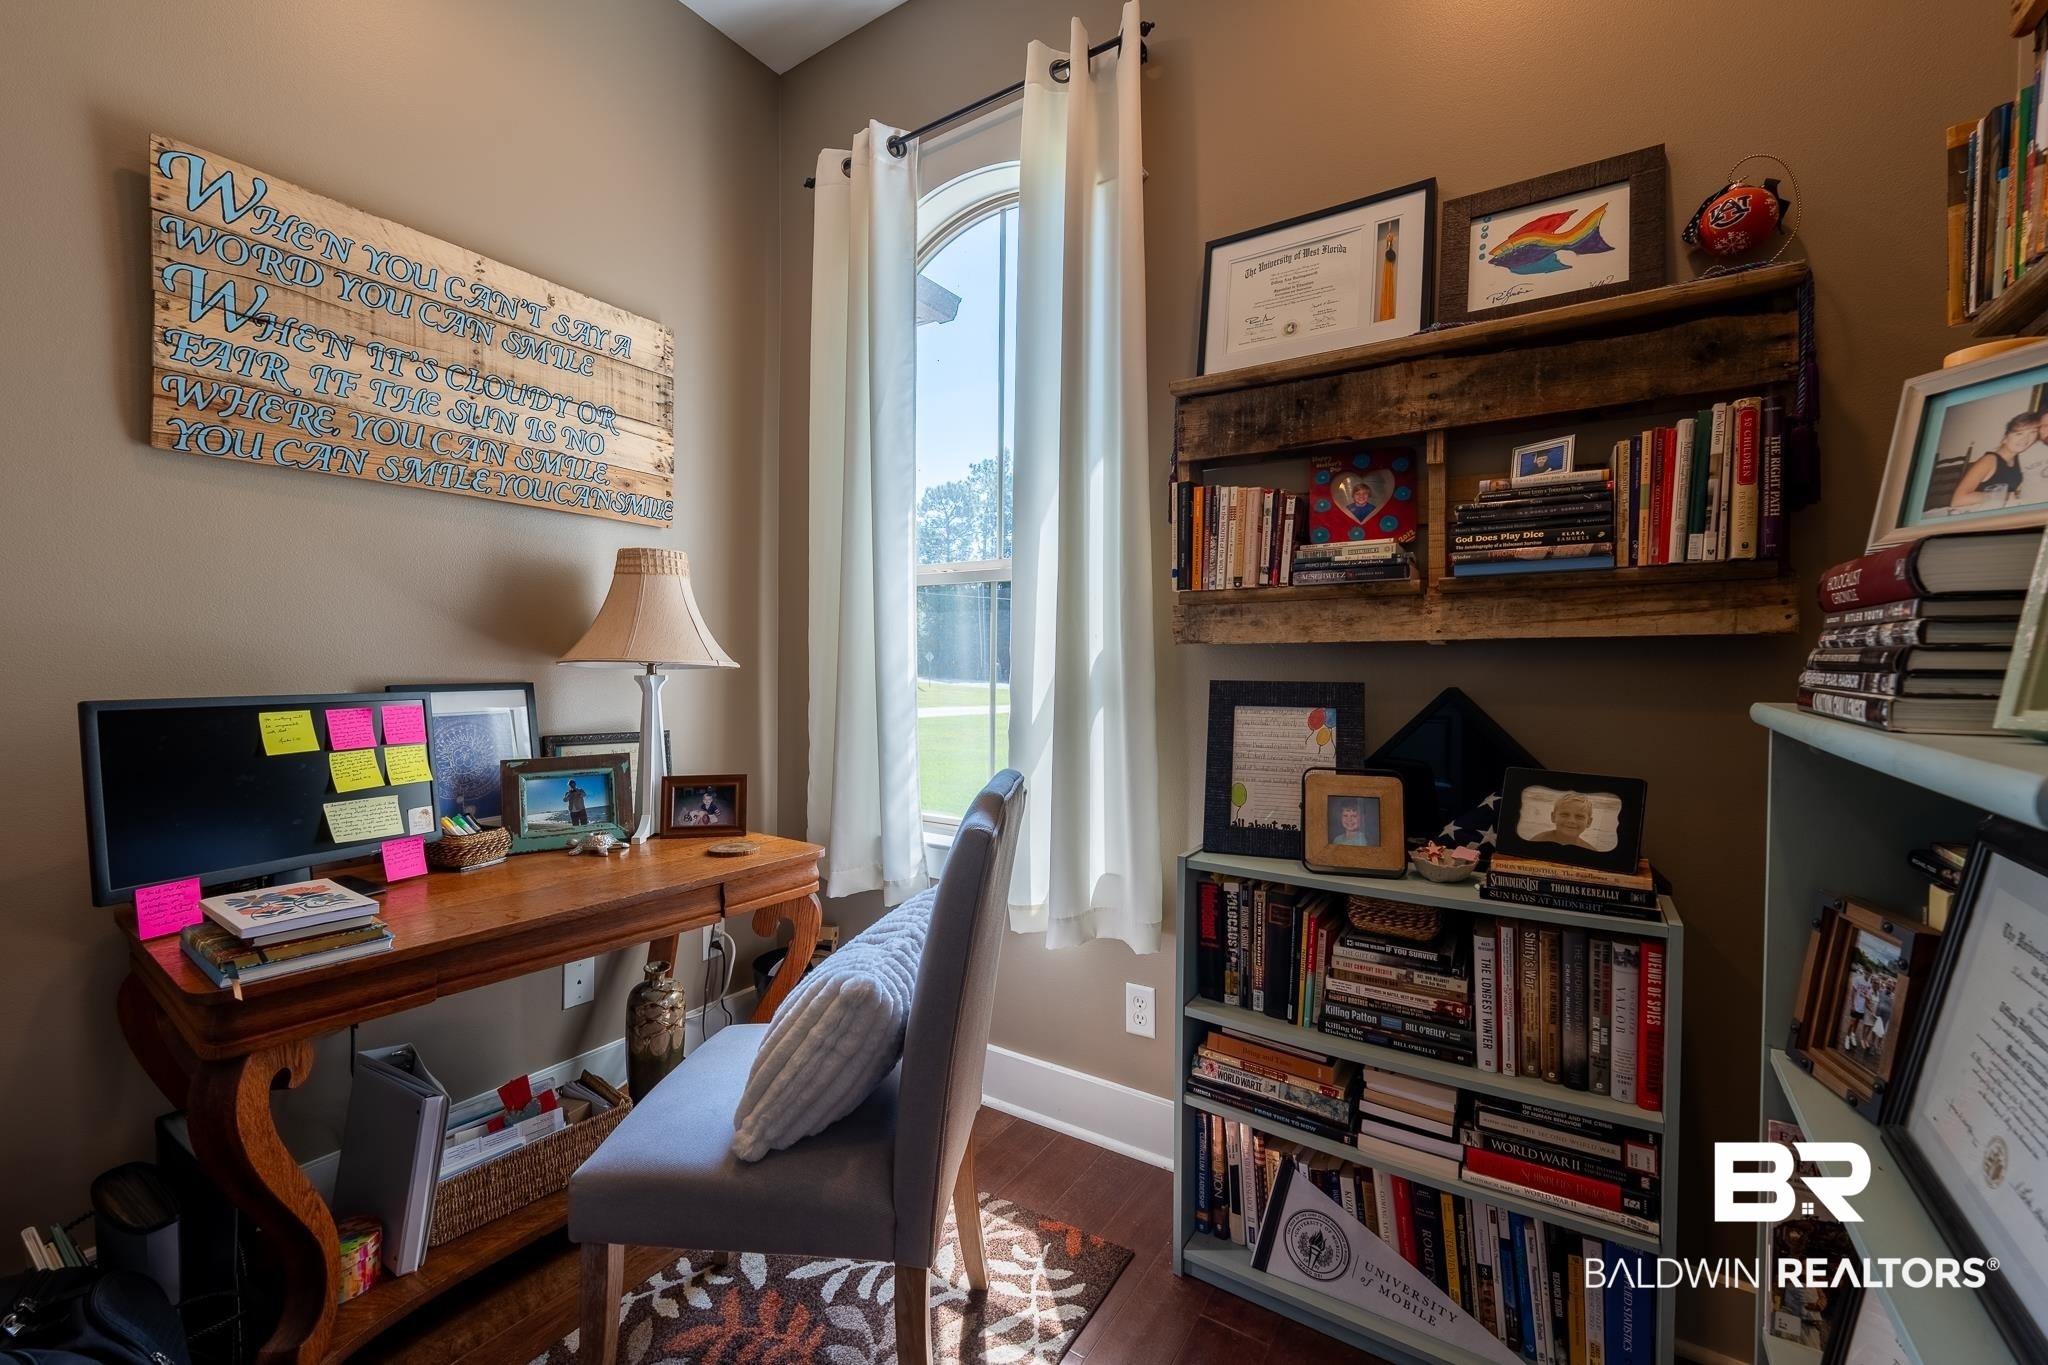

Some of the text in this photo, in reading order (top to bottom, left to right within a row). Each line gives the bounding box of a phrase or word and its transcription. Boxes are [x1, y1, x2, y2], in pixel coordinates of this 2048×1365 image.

[158, 150, 633, 360] WHEN YOU CAN'T SAY A
[1245, 244, 1347, 279] The University of West Florida
[159, 215, 595, 377] WORD YOU CAN SMILE
[161, 263, 620, 436] WHEN IT'S CLOUDY OR
[309, 364, 362, 399] IF
[369, 378, 441, 417] THE
[447, 399, 519, 437] SUN
[524, 416, 556, 445] IS
[560, 427, 605, 456] NO
[349, 412, 424, 450] YOU
[430, 430, 508, 466] CAN
[1714, 410, 1724, 446] I'm No Hero
[166, 418, 263, 460] YOU
[273, 439, 369, 476] CAN
[1742, 430, 1751, 477] CHILDREN
[1769, 435, 1781, 516] THE RIGHT PATH
[1398, 529, 1416, 543] 2012
[1456, 530, 1545, 544] God Does Play Dice
[1301, 571, 1346, 580] AUSCHWITZ
[1232, 818, 1279, 830] all about
[1490, 890, 1510, 899] SUN
[1511, 893, 1536, 903] RAYS
[1552, 898, 1602, 912] MIDNIGHT
[1550, 883, 1620, 900] THOMAS KENEALLY
[1226, 891, 1239, 952] HOLOCAUST
[1385, 943, 1439, 961] IF YOU SURVIVE
[1524, 932, 1536, 967] Shifty's
[1525, 969, 1536, 989] War
[1574, 944, 1583, 1022] THE UNFORGIVING
[1647, 951, 1662, 1026] AVENUE OF SPIES
[1325, 1003, 1350, 1019] Killing
[1351, 1009, 1377, 1024] Patton
[1481, 959, 1493, 1050] THE LONGEST WINTER
[1615, 987, 1626, 1034] VALOR
[1325, 1021, 1364, 1035] Killing the
[1405, 1022, 1446, 1039] BILL O'REILLY
[1217, 1070, 1263, 1092] WORLD WAR II
[1530, 1111, 1552, 1121] HUMAN
[1553, 1116, 1581, 1128] BEHAVIOR
[1533, 1105, 1567, 1118] HOLOCAUST
[1568, 1113, 1580, 1121] AND
[1582, 1115, 1593, 1124] THE
[1491, 1138, 1580, 1171] WORLD WAR II
[1524, 1187, 1551, 1201] WORLD
[1551, 1195, 1570, 1207] WAR
[1445, 1229, 1457, 1280] INTERVIEWS
[1360, 1274, 1437, 1327] of MOBILE
[1365, 1261, 1458, 1323] UNIVERSITY
[1623, 1307, 1632, 1352] STATISTICS
